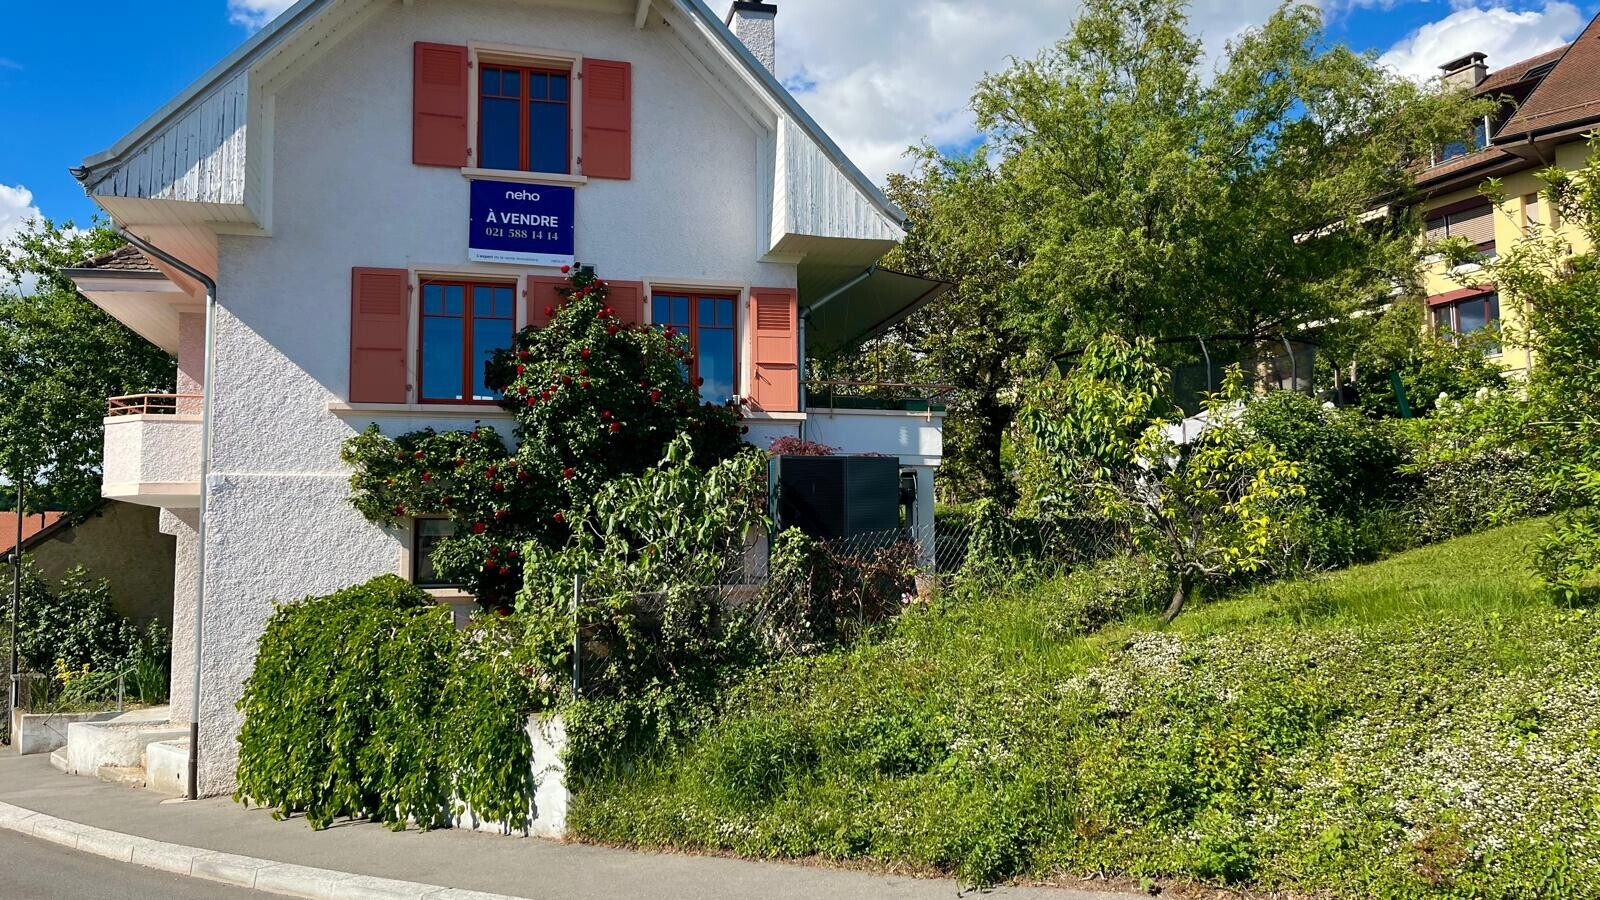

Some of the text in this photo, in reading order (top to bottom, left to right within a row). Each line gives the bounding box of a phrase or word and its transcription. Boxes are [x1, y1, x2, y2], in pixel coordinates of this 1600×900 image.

[505, 189, 540, 201] neho
[486, 208, 559, 227] À VENDRE
[485, 227, 559, 241] 021 588 14 14
